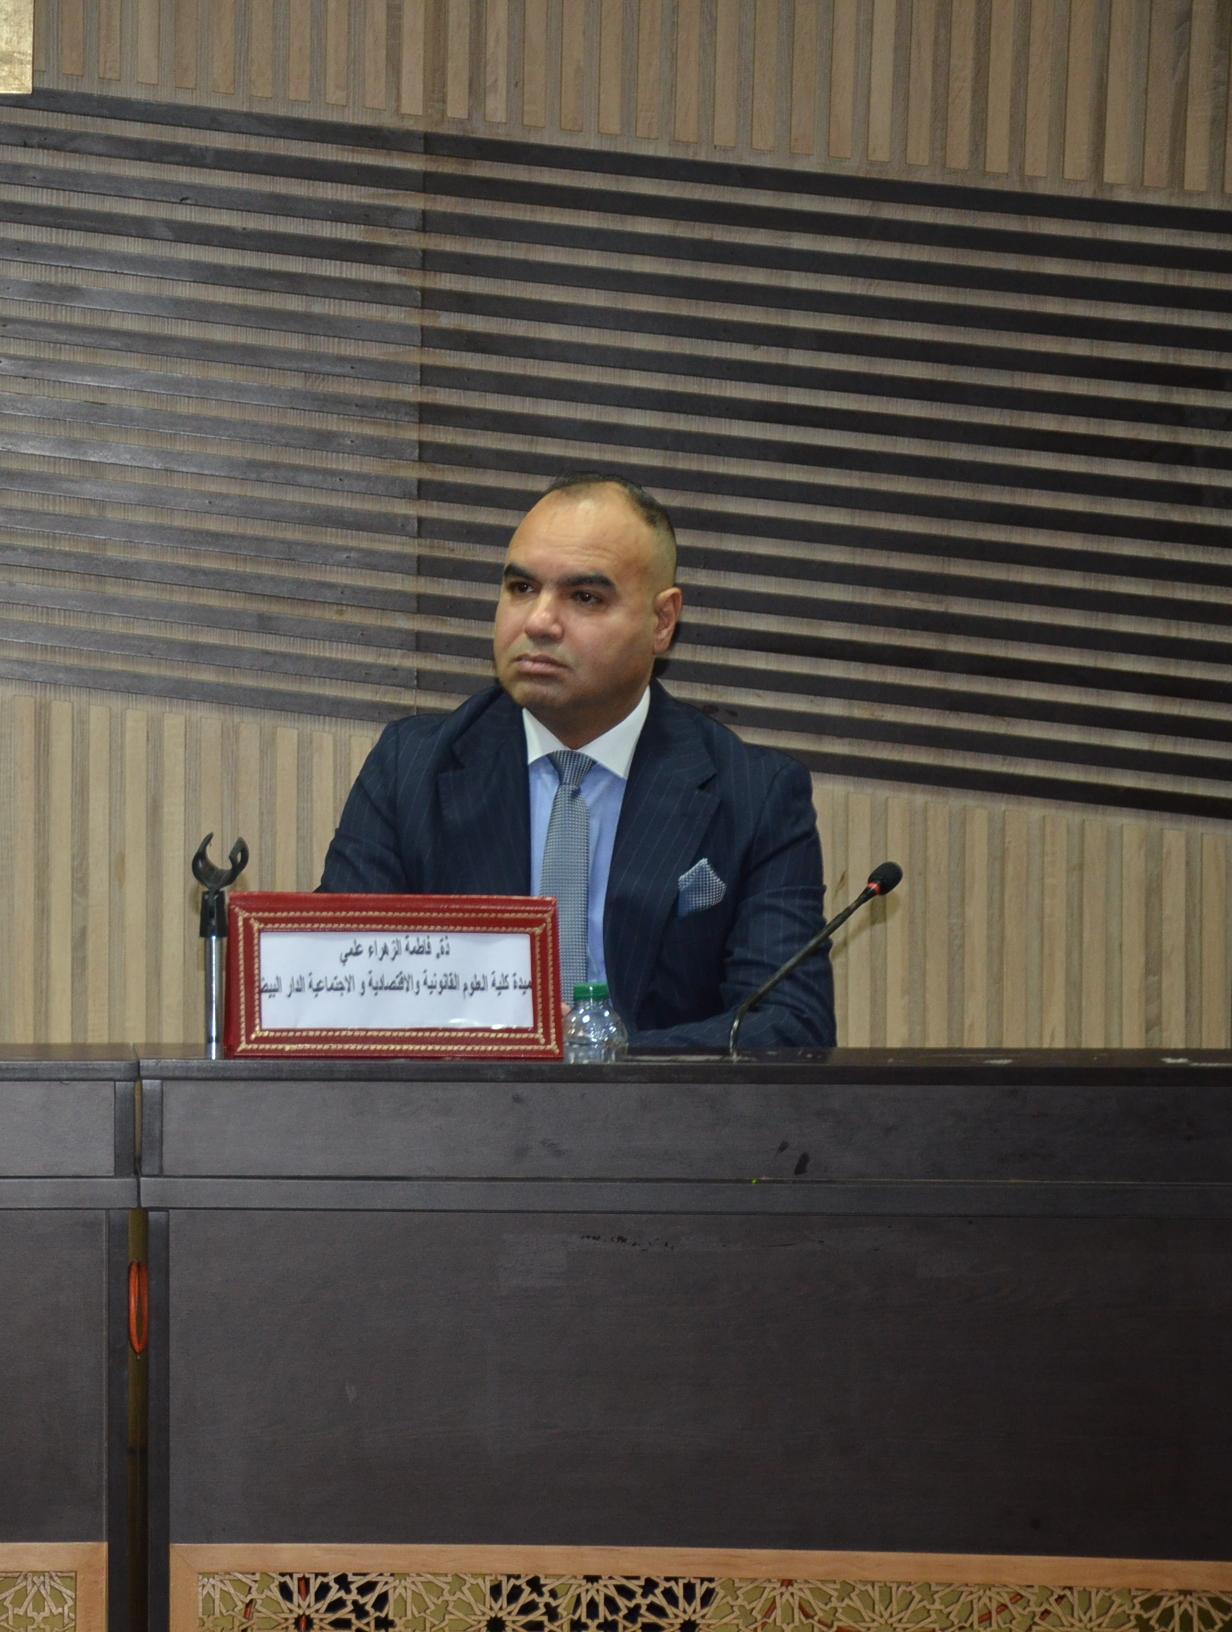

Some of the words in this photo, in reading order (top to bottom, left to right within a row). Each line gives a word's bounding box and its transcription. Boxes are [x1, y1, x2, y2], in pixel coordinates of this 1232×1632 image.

[368, 938, 403, 961] الزهراء
[405, 935, 432, 956] فاطمة
[286, 974, 305, 998] الدار
[308, 972, 356, 997] الاجتماعية
[422, 969, 460, 996] القانونية
[462, 973, 488, 1000] العلوم
[491, 970, 509, 996] كلية
[512, 971, 532, 995] ميدة
